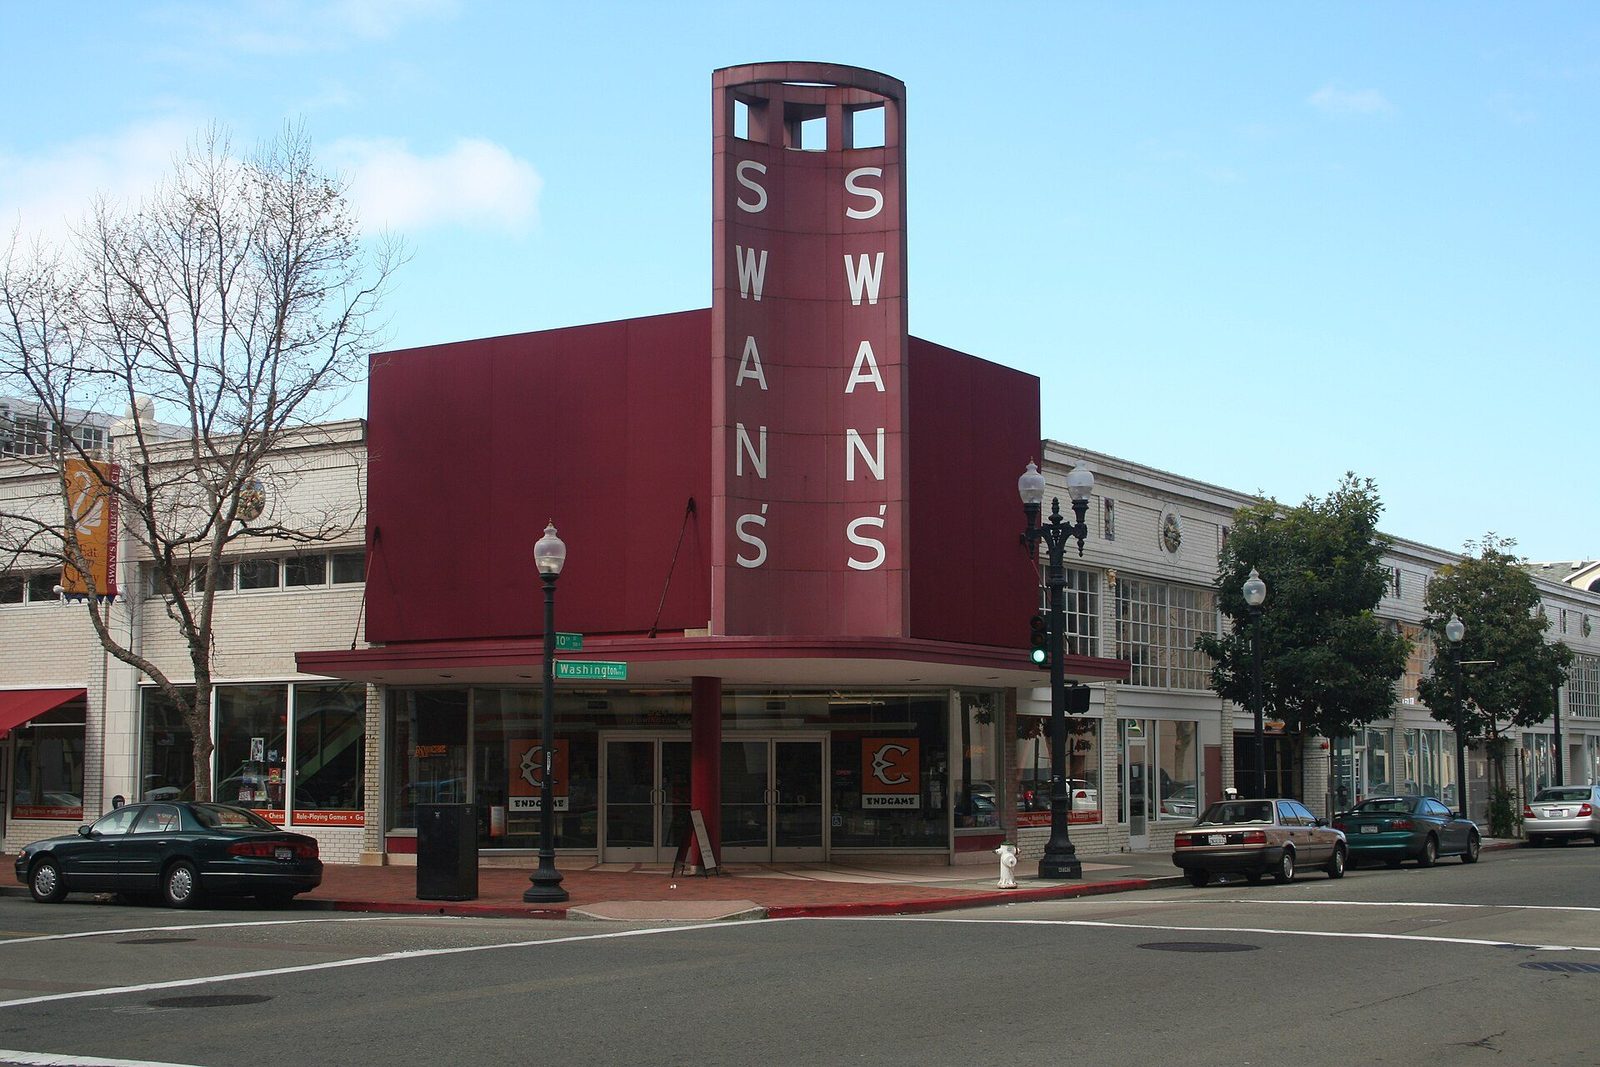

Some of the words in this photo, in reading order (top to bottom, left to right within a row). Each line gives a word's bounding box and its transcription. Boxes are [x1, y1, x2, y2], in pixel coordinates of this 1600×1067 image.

[735, 159, 769, 570] SWAN'S
[843, 166, 887, 572] SWAN'S
[108, 546, 117, 585] SWAN'S
[560, 663, 617, 678] Washington
[514, 799, 564, 808] ENDGE
[866, 797, 915, 805] ENDGAME
[296, 813, 328, 822] Role-Playing
